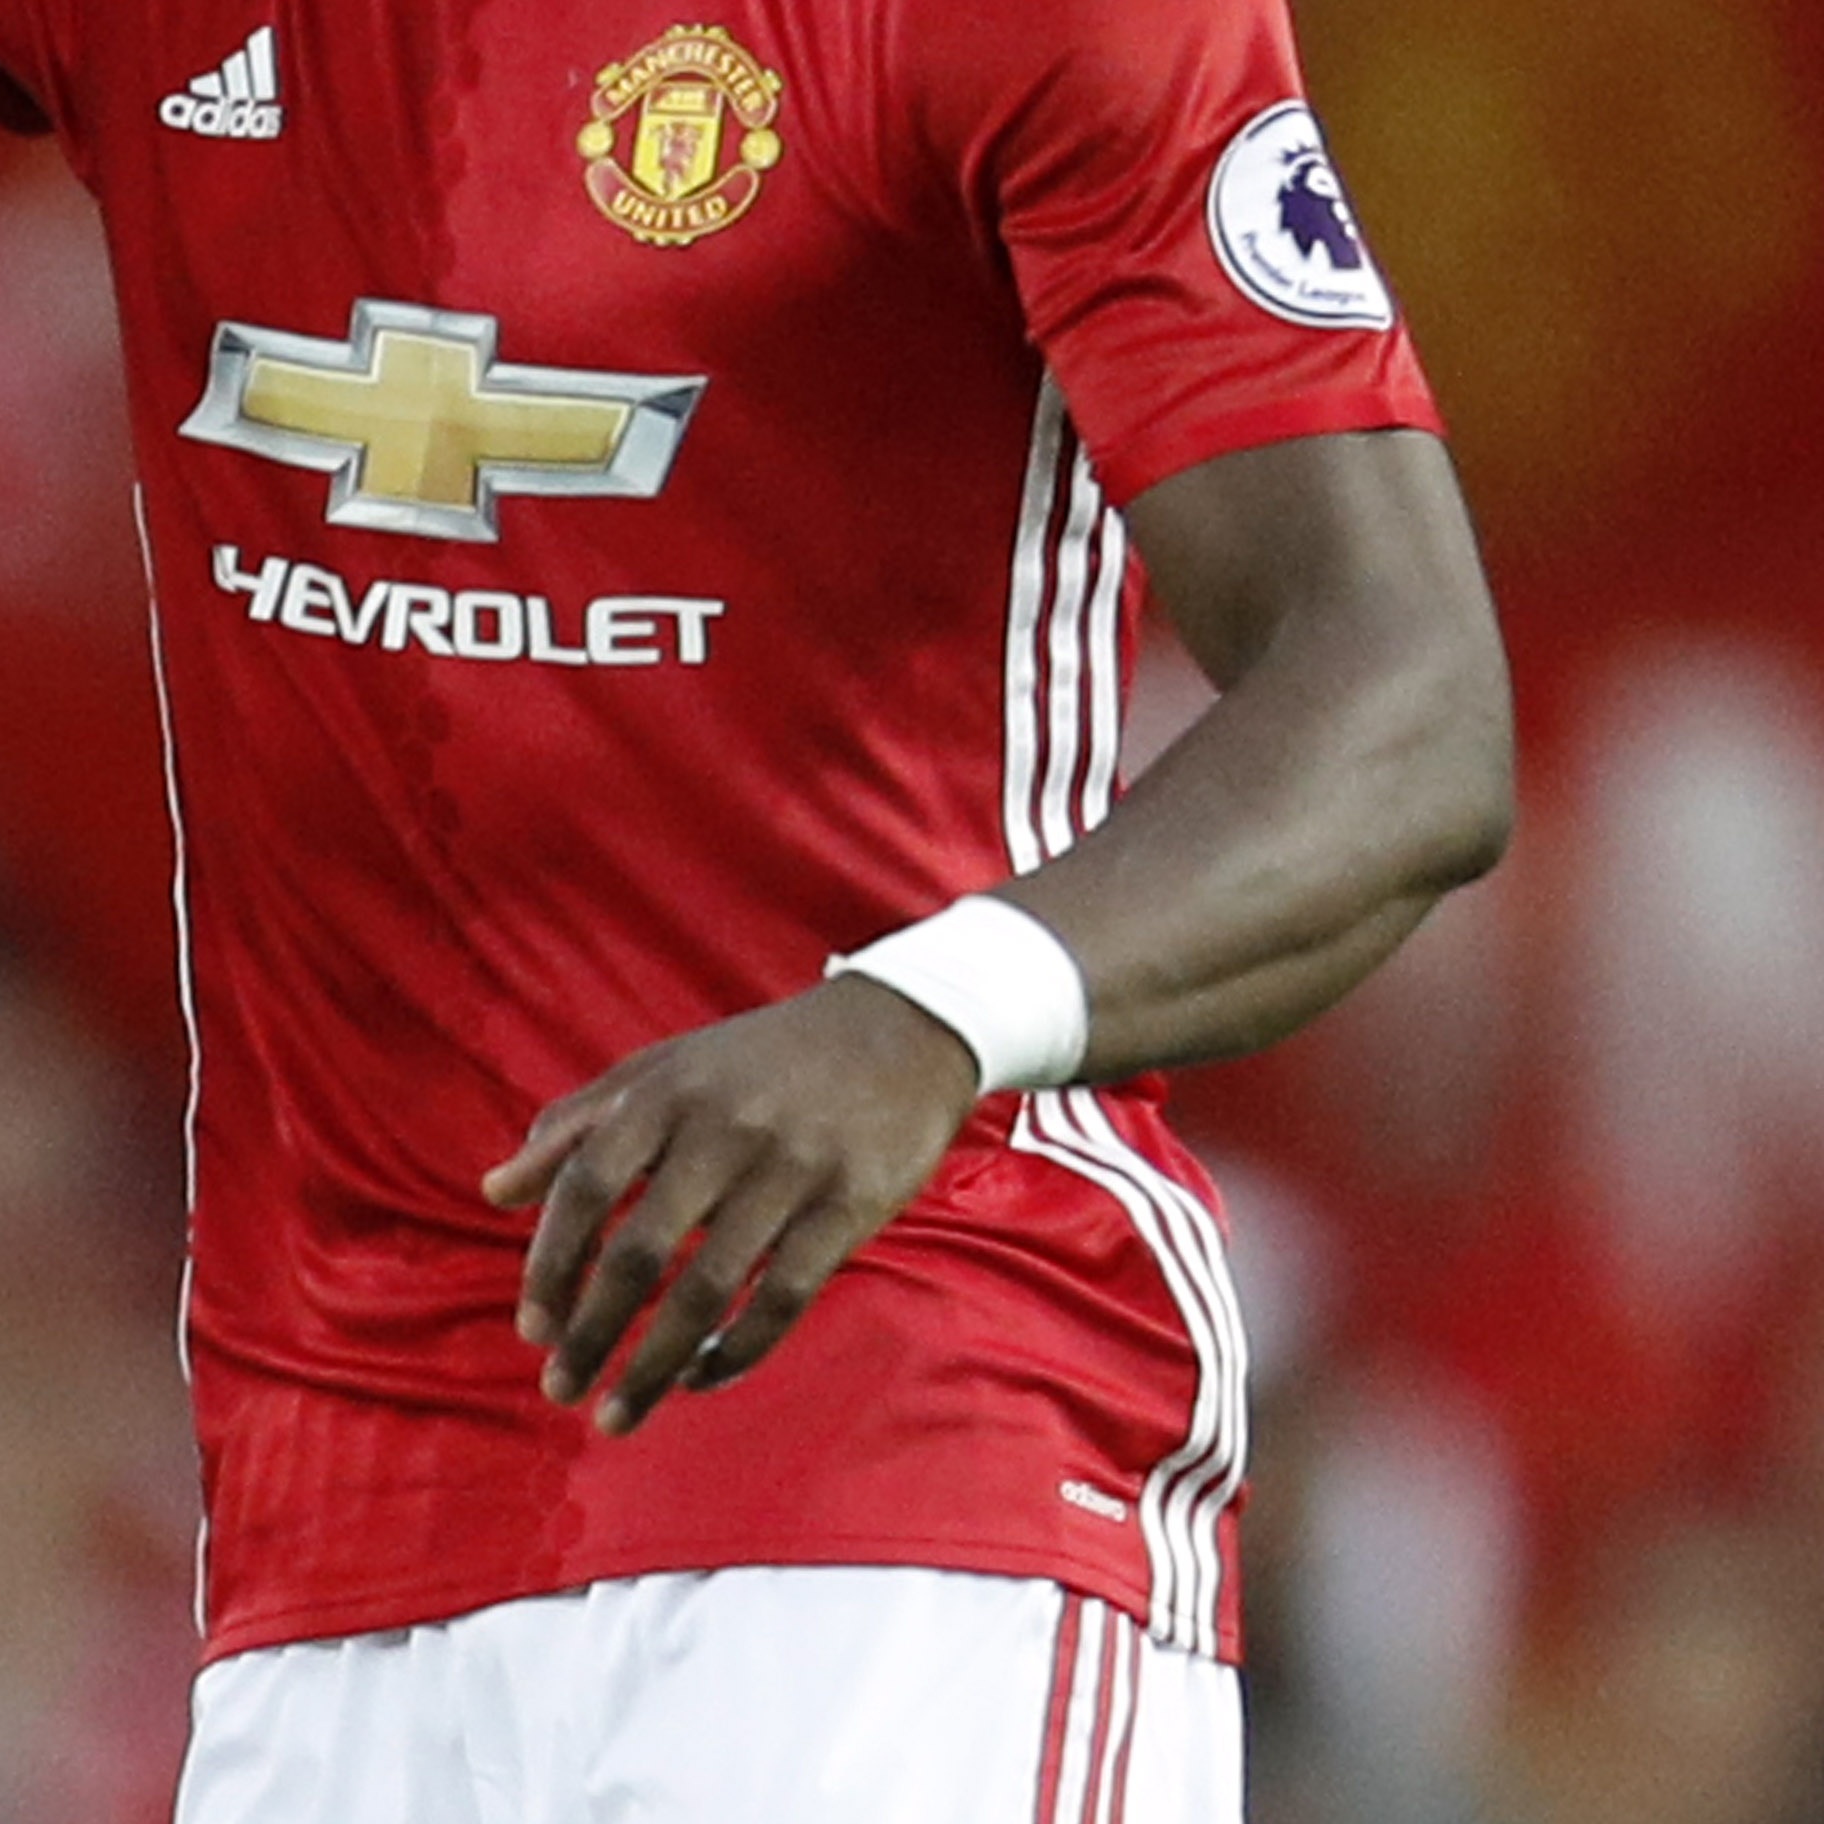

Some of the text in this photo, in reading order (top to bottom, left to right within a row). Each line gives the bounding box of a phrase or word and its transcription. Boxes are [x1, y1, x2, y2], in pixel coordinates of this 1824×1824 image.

[605, 42, 764, 113] MANCHESTER
[612, 190, 729, 229] UNITED
[212, 545, 726, 665] HEVROLET
